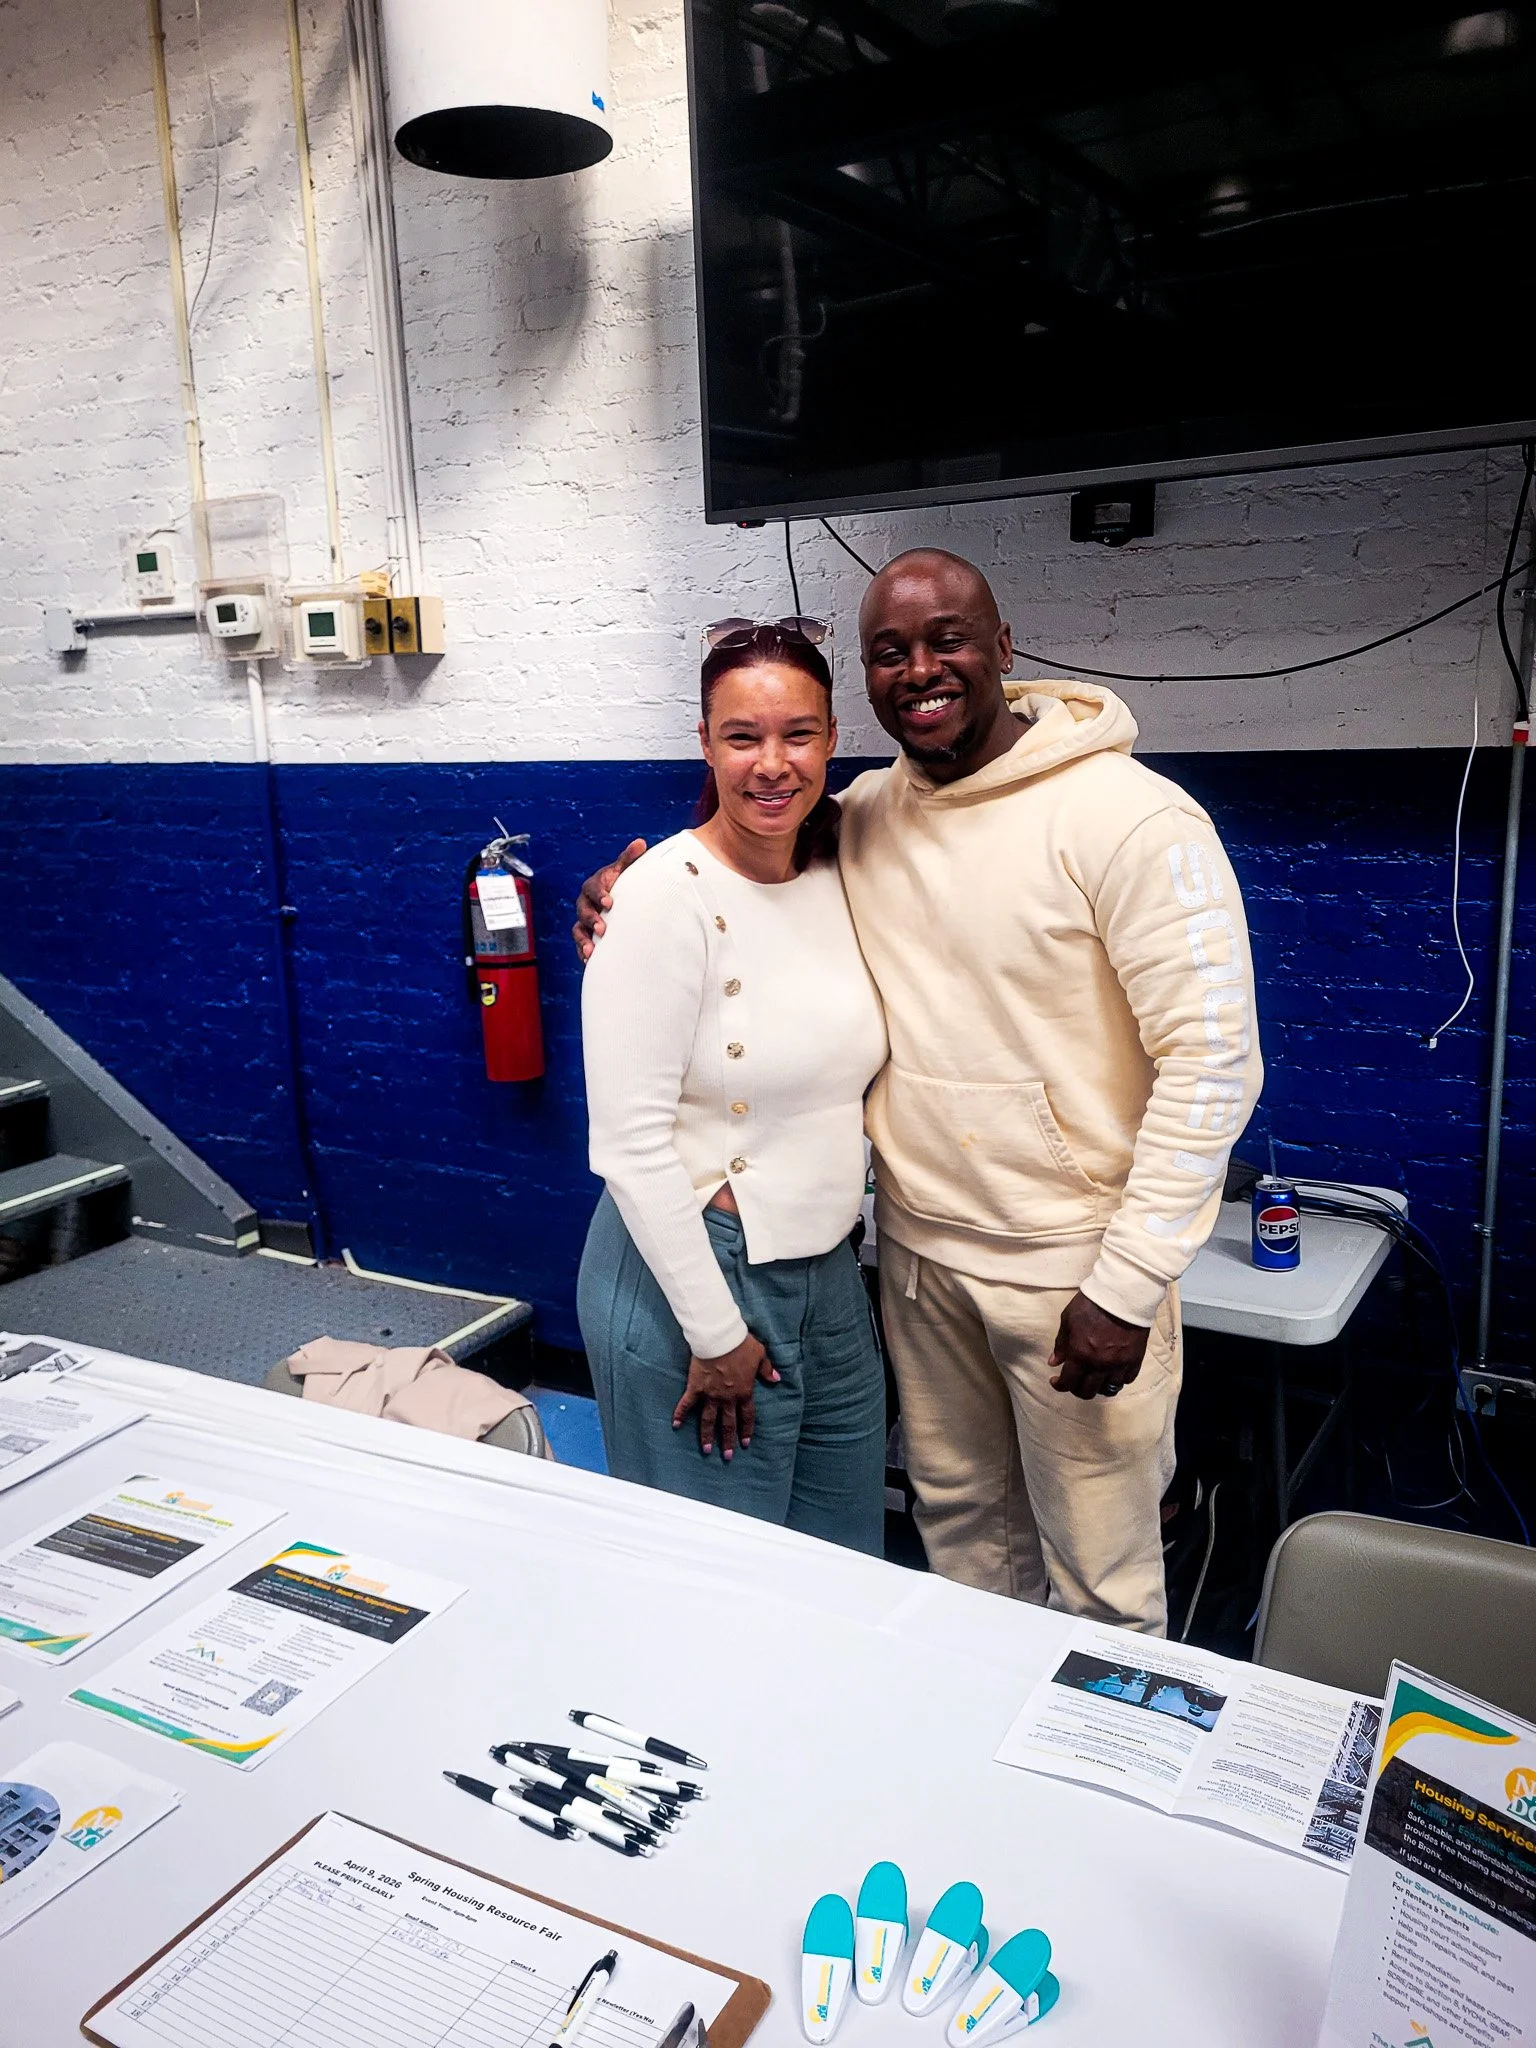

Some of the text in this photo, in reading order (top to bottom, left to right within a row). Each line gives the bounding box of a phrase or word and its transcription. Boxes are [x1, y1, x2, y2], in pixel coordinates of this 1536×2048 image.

[1259, 1222, 1299, 1235] PEPSI
[1414, 1779, 1536, 1853] Housing Service
[1402, 1833, 1443, 1860] the Bronx.
[1404, 1822, 1535, 1899] provides free housing services to
[1407, 1811, 1427, 1827] Safe,
[1427, 1822, 1455, 1842] stable,
[1455, 1838, 1471, 1850] and
[1471, 1847, 1514, 1874] affordable
[313, 1860, 340, 1876] PLEASE
[341, 1871, 362, 1886] PRINT
[362, 1882, 395, 1901] CLEARLY
[343, 1859, 402, 1889] April 9, 2026
[1406, 1853, 1422, 1866] you
[1423, 1862, 1436, 1873] are
[1437, 1869, 1462, 1889] facing
[1463, 1883, 1496, 1908] housing
[408, 1871, 563, 1942] Spring Housing Resource Fair
[1392, 1881, 1404, 1892] For
[1404, 1889, 1432, 1909] Renters
[1440, 1910, 1470, 1930] Tenants
[1394, 1870, 1500, 1935] Our Services Include:
[1395, 1929, 1417, 1946] issues
[1399, 1909, 1487, 1965] Housing court advocacy
[1401, 1899, 1501, 1961] Eviction prevention support
[510, 1959, 531, 1973] Contact
[1389, 1960, 1414, 1979] Access
[1415, 1975, 1423, 1984] to
[1424, 1981, 1452, 2003] Section
[1391, 1949, 1408, 1963] Rent
[1408, 1960, 1449, 1990] overcharge
[1449, 1986, 1464, 1999] and
[1465, 1995, 1485, 2011] lease
[1393, 1939, 1461, 1984] Landlord mediation
[1397, 1919, 1514, 1994] Help with repairs, mold, and pest
[1382, 1991, 1410, 2011] support
[1384, 1980, 1408, 1998] Tenant
[1408, 1995, 1448, 2025] workshops
[1449, 2021, 1463, 2034] and
[1426, 1994, 1440, 2007] and
[1441, 2004, 1461, 2020] other
